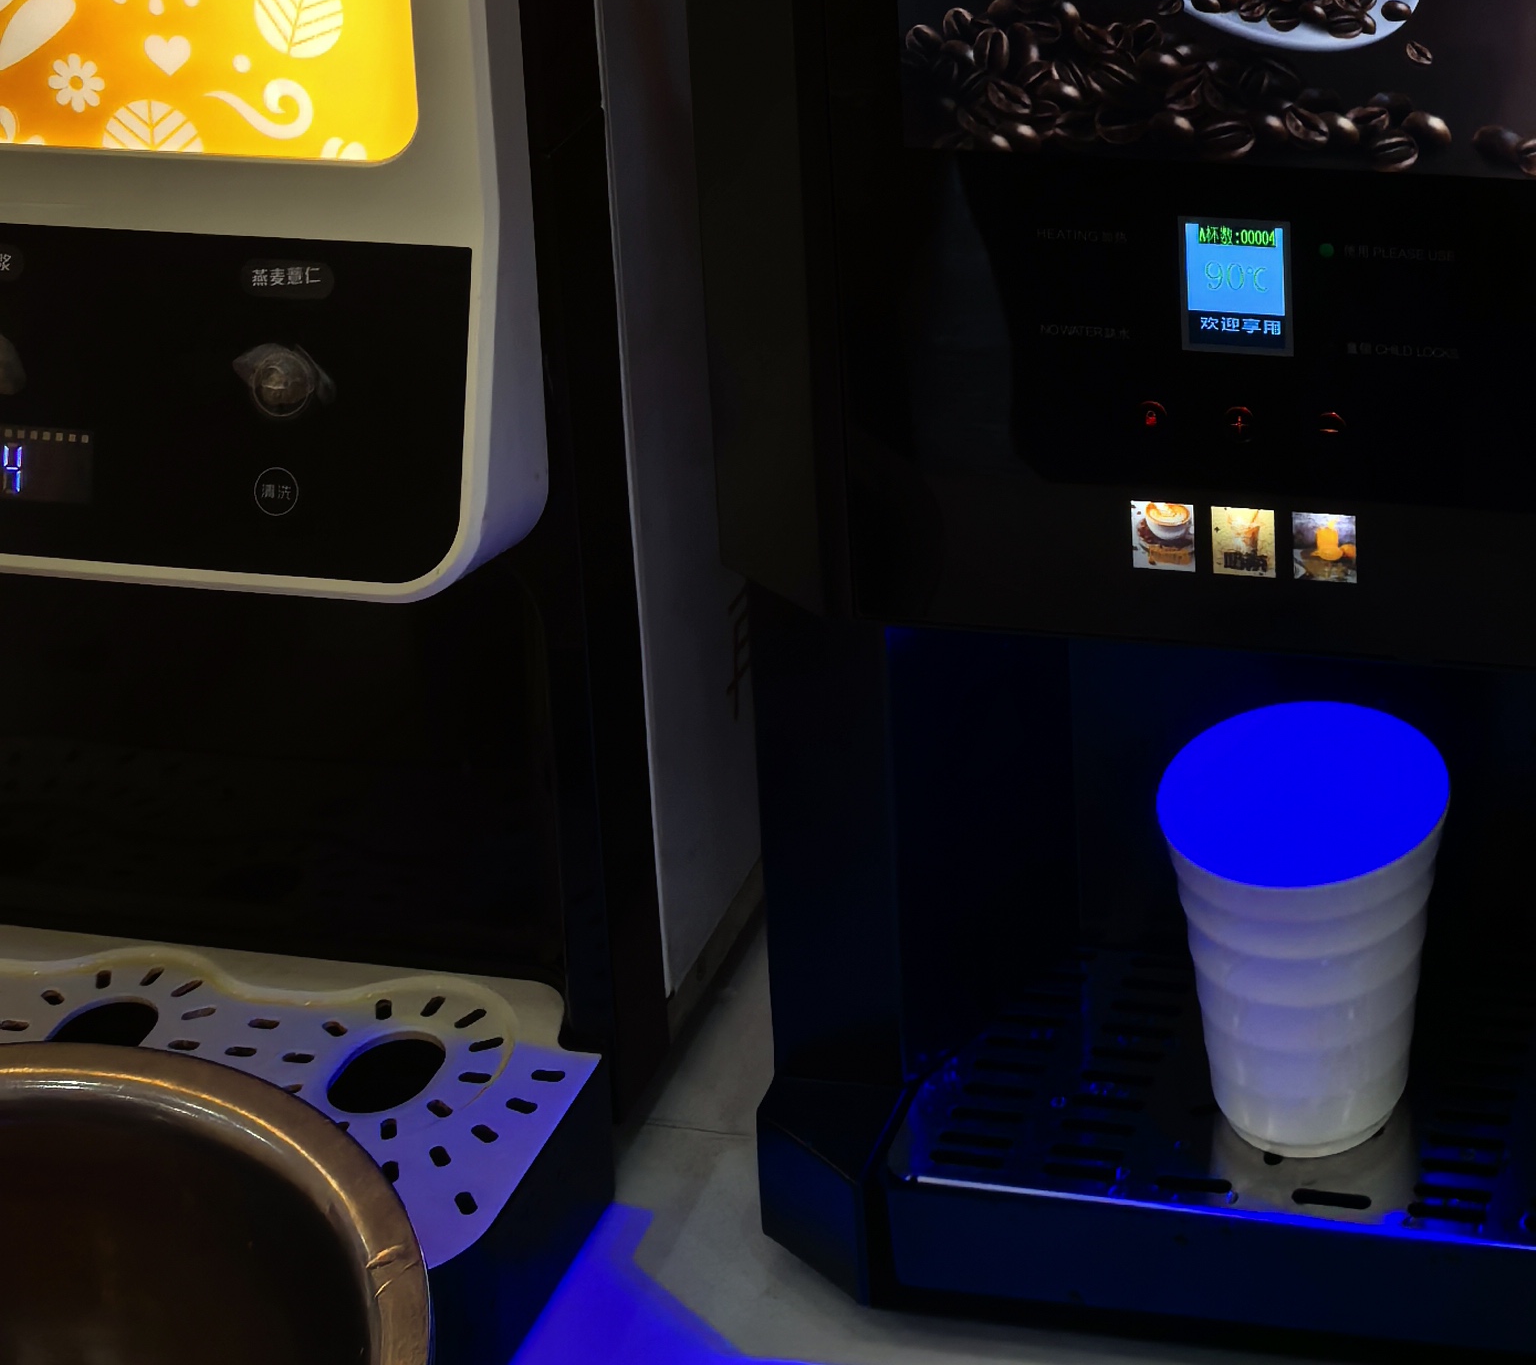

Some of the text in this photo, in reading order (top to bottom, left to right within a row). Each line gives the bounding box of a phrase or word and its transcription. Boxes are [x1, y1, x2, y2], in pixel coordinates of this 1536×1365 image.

[1036, 228, 1098, 242] HEATING
[1372, 246, 1425, 260] PLEASE
[1200, 316, 1281, 336] 欢迎享用
